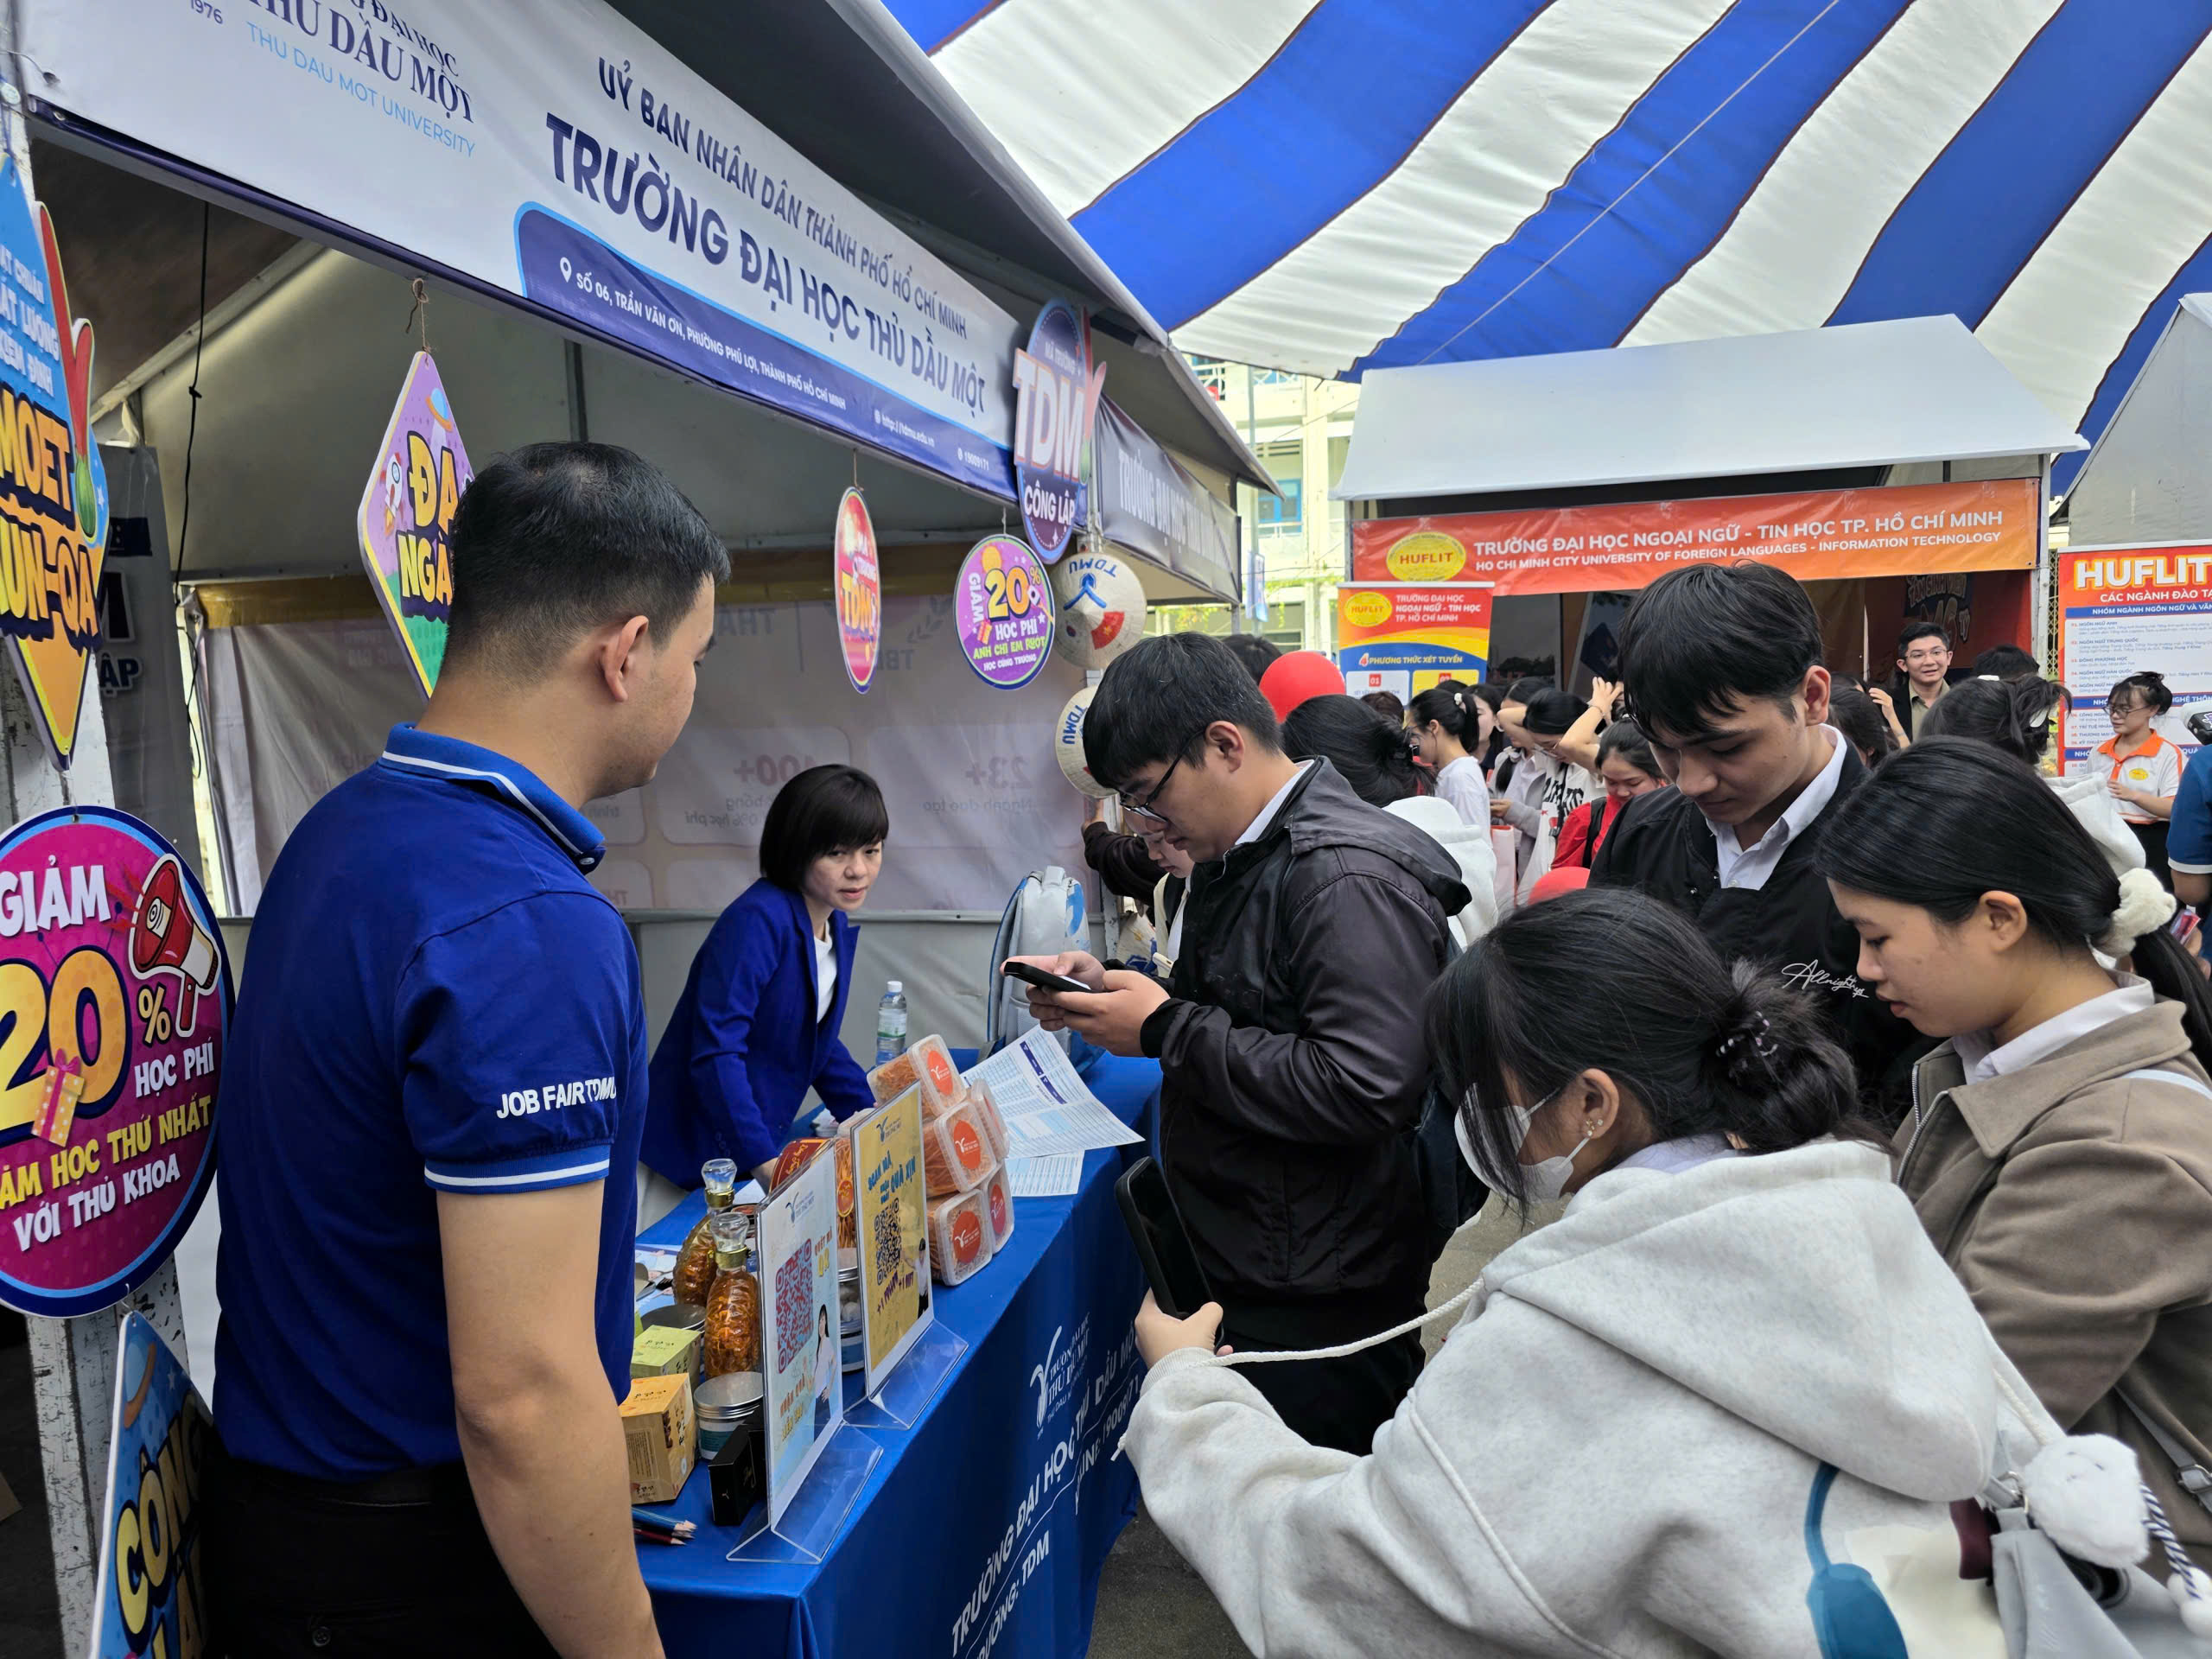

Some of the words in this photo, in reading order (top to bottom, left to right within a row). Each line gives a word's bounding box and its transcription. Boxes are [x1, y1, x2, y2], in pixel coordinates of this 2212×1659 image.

[328, 9, 404, 81] DẦU
[410, 54, 474, 123] MỘT
[412, 29, 459, 77] HỌC
[246, 21, 288, 60] THU
[293, 48, 334, 84] DAU
[339, 73, 378, 107] MOT
[382, 95, 475, 157] UNIVERSITY
[641, 87, 690, 154] BAN
[696, 129, 757, 200] NHÂN
[761, 175, 802, 229] DÂN
[806, 207, 856, 268] THÀNH
[861, 246, 893, 288] PHỐ
[893, 265, 913, 303] HỒ
[914, 290, 938, 321] CHÍ
[938, 304, 967, 340] MINH
[546, 112, 729, 265] TRƯỜNG
[740, 229, 793, 312] ĐẠI
[799, 267, 861, 343] HỌC
[864, 307, 906, 367] THỦ
[911, 327, 949, 391] DẦU
[951, 362, 985, 418] MỘT
[21, 299, 60, 361] LƯỢNG
[576, 271, 593, 293] SỐ
[595, 282, 613, 306] 06,
[614, 289, 643, 318] TRẦN
[645, 305, 667, 328] VĂN
[668, 316, 686, 340] ƠN,
[687, 327, 724, 356] PHƯỜNG
[725, 343, 743, 365] PHÚ
[744, 353, 760, 375] LỢI,
[760, 361, 786, 385] THÀNH
[787, 371, 803, 390] PHỐ
[803, 377, 815, 396] HỒ
[815, 385, 829, 402] CHÍ
[829, 391, 846, 410] MINH
[28, 352, 54, 397] ĐỊNH
[1014, 350, 1085, 482] TDM
[1024, 480, 1057, 522] CÔNG
[1058, 489, 1075, 533] LẬP
[1474, 537, 1548, 556] TRƯỜNG
[1552, 536, 1584, 554] ĐẠI
[1589, 534, 1629, 551] HỌC
[1633, 531, 1693, 548] NGOẠI
[1699, 524, 1741, 543] NGỮ
[1758, 524, 1788, 539] TIN
[1794, 521, 1835, 539] HỌC
[1840, 518, 1869, 534] TP.
[1875, 512, 1905, 531] HỒ
[1911, 510, 1946, 530] CHÍ
[1950, 511, 2002, 528] MINH
[1476, 561, 1493, 571] HO
[1496, 559, 1516, 570] CHI
[1519, 557, 1550, 569] MINH
[1552, 556, 1580, 567] CITY
[1581, 553, 1652, 567] UNIVERSITY
[1654, 551, 1671, 562] OF
[1674, 549, 1727, 561] FOREIGN
[1730, 543, 1808, 557] LANGUAGES
[1819, 537, 1909, 551] INFORMATION
[1911, 531, 2002, 546] TECHNOLOGY
[1029, 566, 1041, 586] %
[1069, 558, 1118, 578] TDMU
[1399, 552, 1453, 564] HUFLIT
[2076, 556, 2212, 589] HUFLIT
[984, 567, 1030, 620] 20
[1351, 606, 1383, 614] HUFLIT
[1395, 593, 1429, 603] TRƯỜNG
[1430, 594, 1446, 603] ĐẠI
[1446, 594, 1465, 604] HỌC
[1395, 604, 1422, 614] NGOẠI
[1423, 602, 1441, 613] NGỮ
[1463, 604, 1481, 614] HỌC
[2100, 591, 2124, 603] CÁC
[2126, 588, 2170, 601] NGÀNH
[2171, 588, 2198, 600] ĐÀO
[2117, 606, 2144, 614] NGÀNH
[2145, 605, 2167, 613] NGÔN
[2169, 603, 2186, 612] NGỮ
[995, 623, 1018, 643] HỌC
[1020, 618, 1038, 636] PHÍ
[1408, 613, 1421, 622] HỒ
[1421, 613, 1436, 622] CHÍ
[973, 645, 991, 660] ANH
[1011, 640, 1023, 652] EM
[1358, 652, 1370, 667] 4
[1423, 655, 1436, 664] XÉT
[1438, 653, 1463, 663] TUYỂN
[1370, 677, 1380, 685] 01
[1061, 704, 1088, 745] TDMU
[0, 854, 111, 938] GIẢM
[0, 949, 128, 1131] 20
[138, 982, 172, 1048] %
[134, 1054, 177, 1097] HỌC
[183, 1036, 215, 1080] PHÍ
[496, 1089, 541, 1119] JOB
[542, 1082, 586, 1110] FAIR
[585, 1076, 617, 1103] TDMU
[50, 1138, 100, 1190] HỌC
[106, 1113, 152, 1164] THỨ
[158, 1092, 212, 1145] NHẤT
[13, 1199, 61, 1252] VỚI
[67, 1175, 116, 1228] THỦ
[123, 1153, 181, 1205] KHOA
[1048, 1369, 1065, 1407] THỦ
[952, 1523, 1014, 1658] TRƯỜNG
[1016, 1474, 1039, 1539] ĐẠI
[1044, 1427, 1074, 1494] HỌC
[1095, 1349, 1117, 1407] DẦU
[1022, 1529, 1050, 1586] TDM
